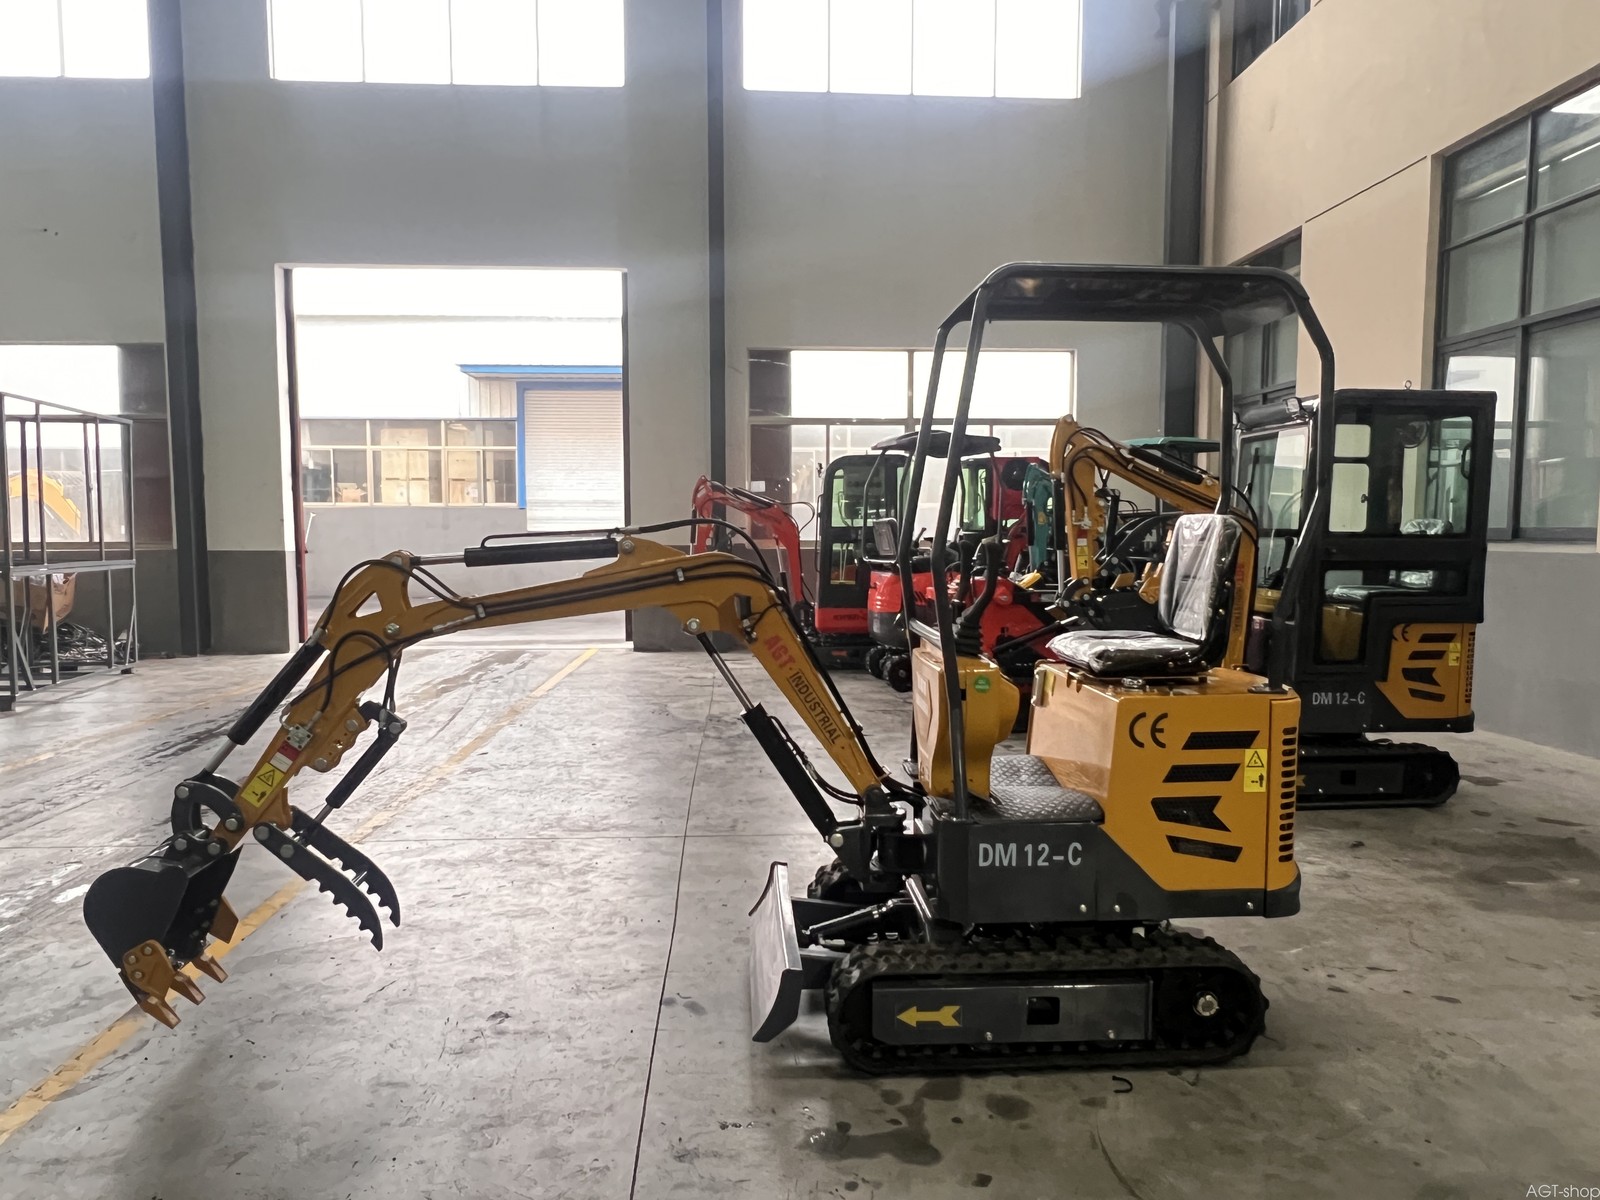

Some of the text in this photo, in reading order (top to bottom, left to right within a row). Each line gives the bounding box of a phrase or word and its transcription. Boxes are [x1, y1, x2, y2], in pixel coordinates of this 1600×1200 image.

[764, 635, 842, 745] AGT INDUSTRIAL
[1129, 712, 1168, 748] CE
[979, 842, 1082, 867] DM 12-C
